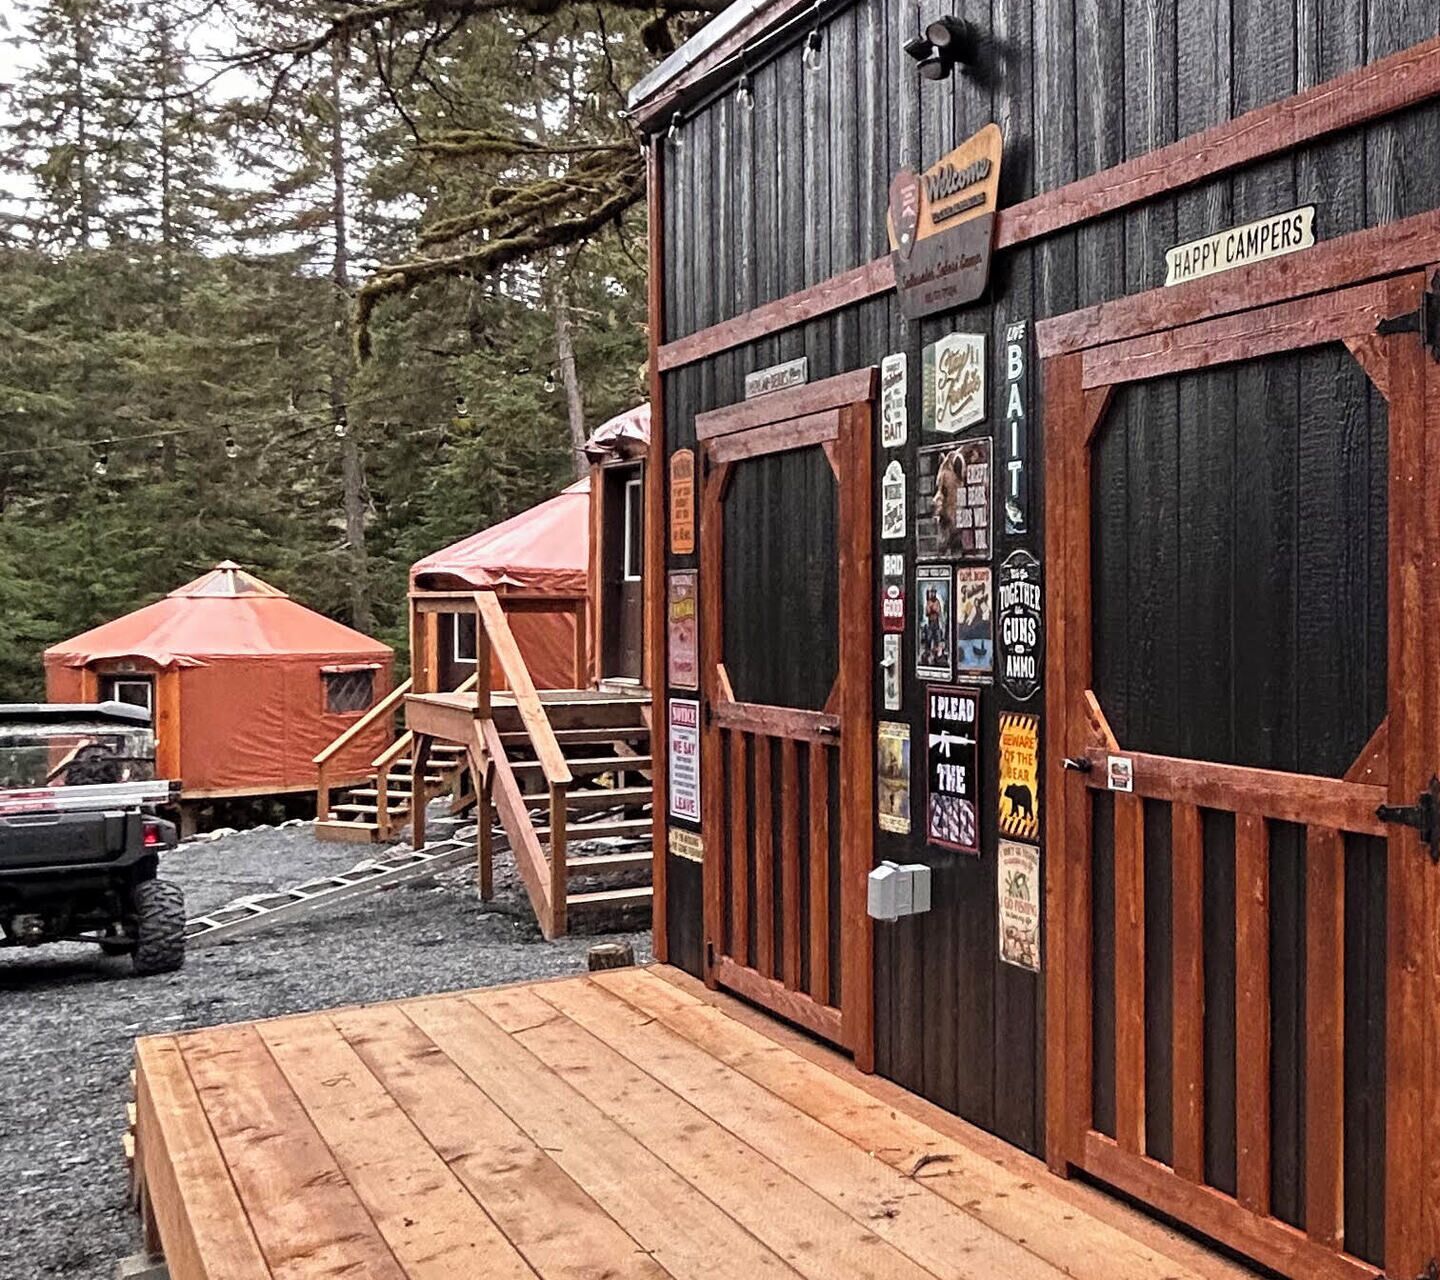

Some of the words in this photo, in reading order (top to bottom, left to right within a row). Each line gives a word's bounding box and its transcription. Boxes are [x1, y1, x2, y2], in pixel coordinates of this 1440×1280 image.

[925, 158, 993, 204] Welcome
[1173, 238, 1220, 280] HAPPY
[1226, 215, 1303, 263] CAMPERS
[1007, 325, 1025, 342] LIVE
[884, 422, 902, 442] BAIT
[1007, 345, 1024, 496] BAIT
[1000, 581, 1040, 611] TOGETHER
[1003, 618, 1036, 646] GUNS
[1006, 655, 1035, 678] AMMO
[931, 696, 935, 718] I
[938, 696, 975, 722] PLEAD
[1003, 734, 1034, 749] BEWARE
[1004, 750, 1014, 763] OF
[1017, 752, 1032, 766] THE
[937, 763, 965, 794] THE
[1006, 767, 1029, 781] BEAR
